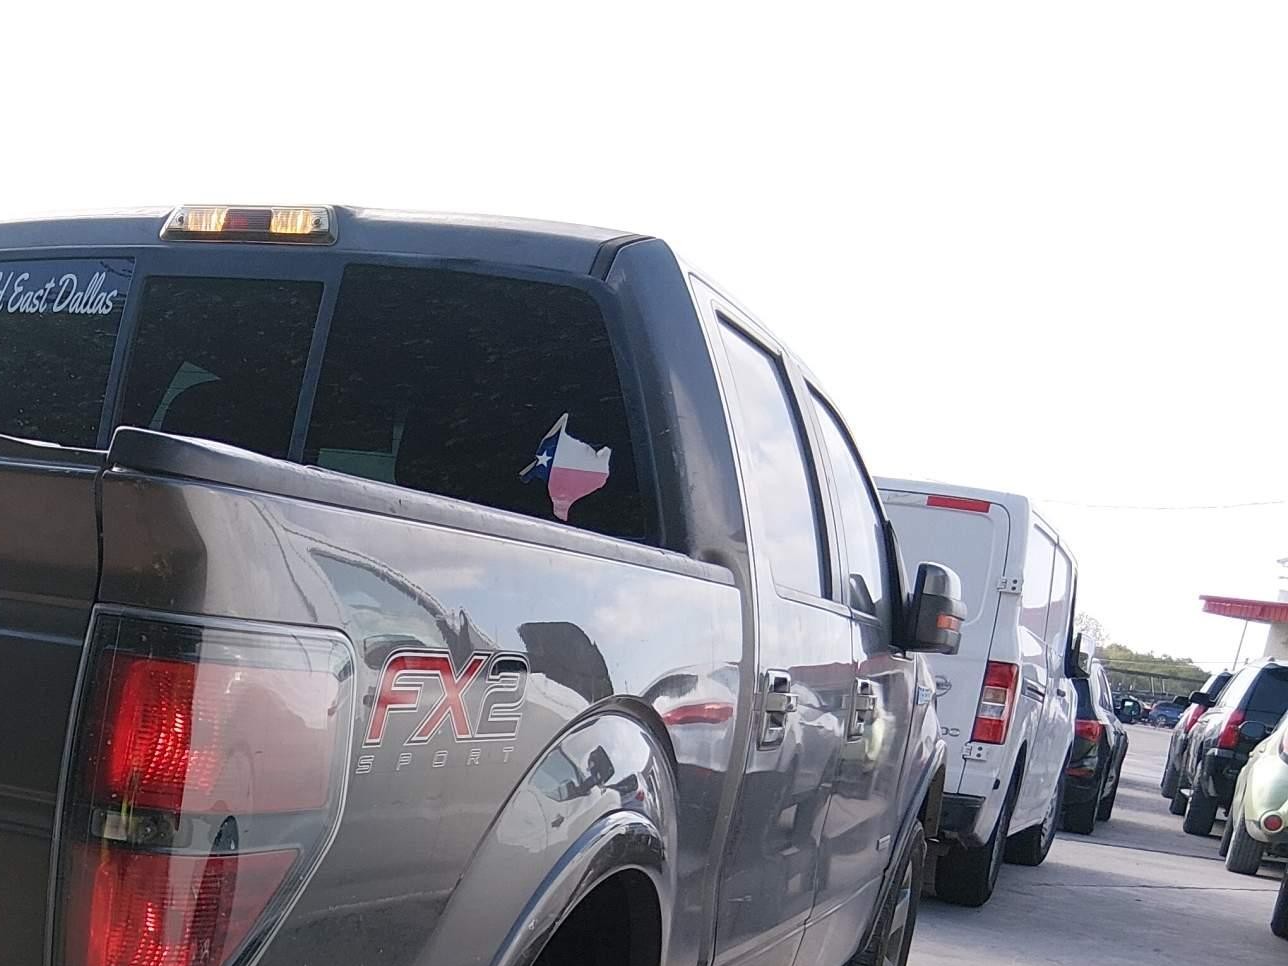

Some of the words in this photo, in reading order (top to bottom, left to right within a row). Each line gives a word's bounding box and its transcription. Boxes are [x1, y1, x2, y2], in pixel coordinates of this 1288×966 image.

[7, 272, 56, 314] East
[53, 271, 118, 314] Dallas
[362, 647, 531, 748] FX2
[355, 746, 515, 775] SPORT
